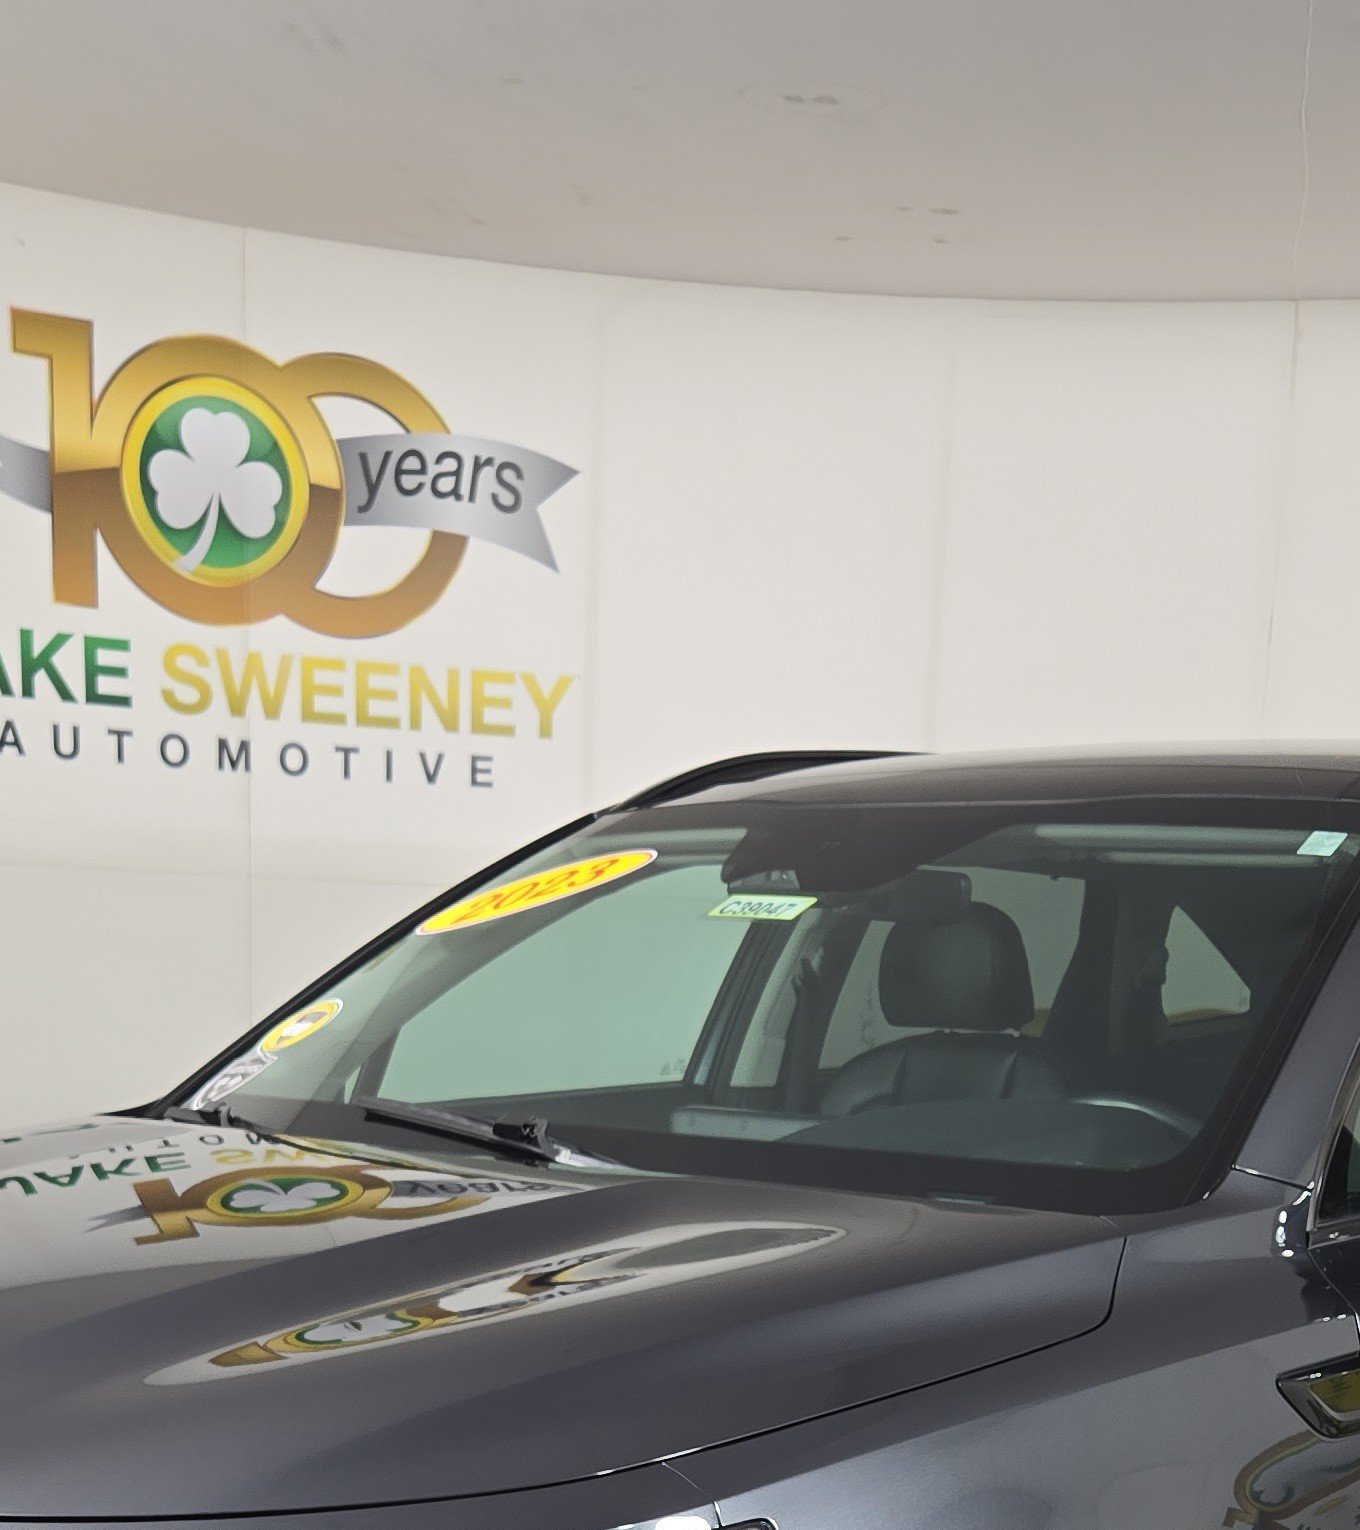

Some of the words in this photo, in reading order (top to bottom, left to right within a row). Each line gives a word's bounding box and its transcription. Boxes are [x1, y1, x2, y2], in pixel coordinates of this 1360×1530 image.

[357, 449, 526, 514] years
[160, 642, 575, 740] SWEENEY
[450, 858, 620, 925] 2023
